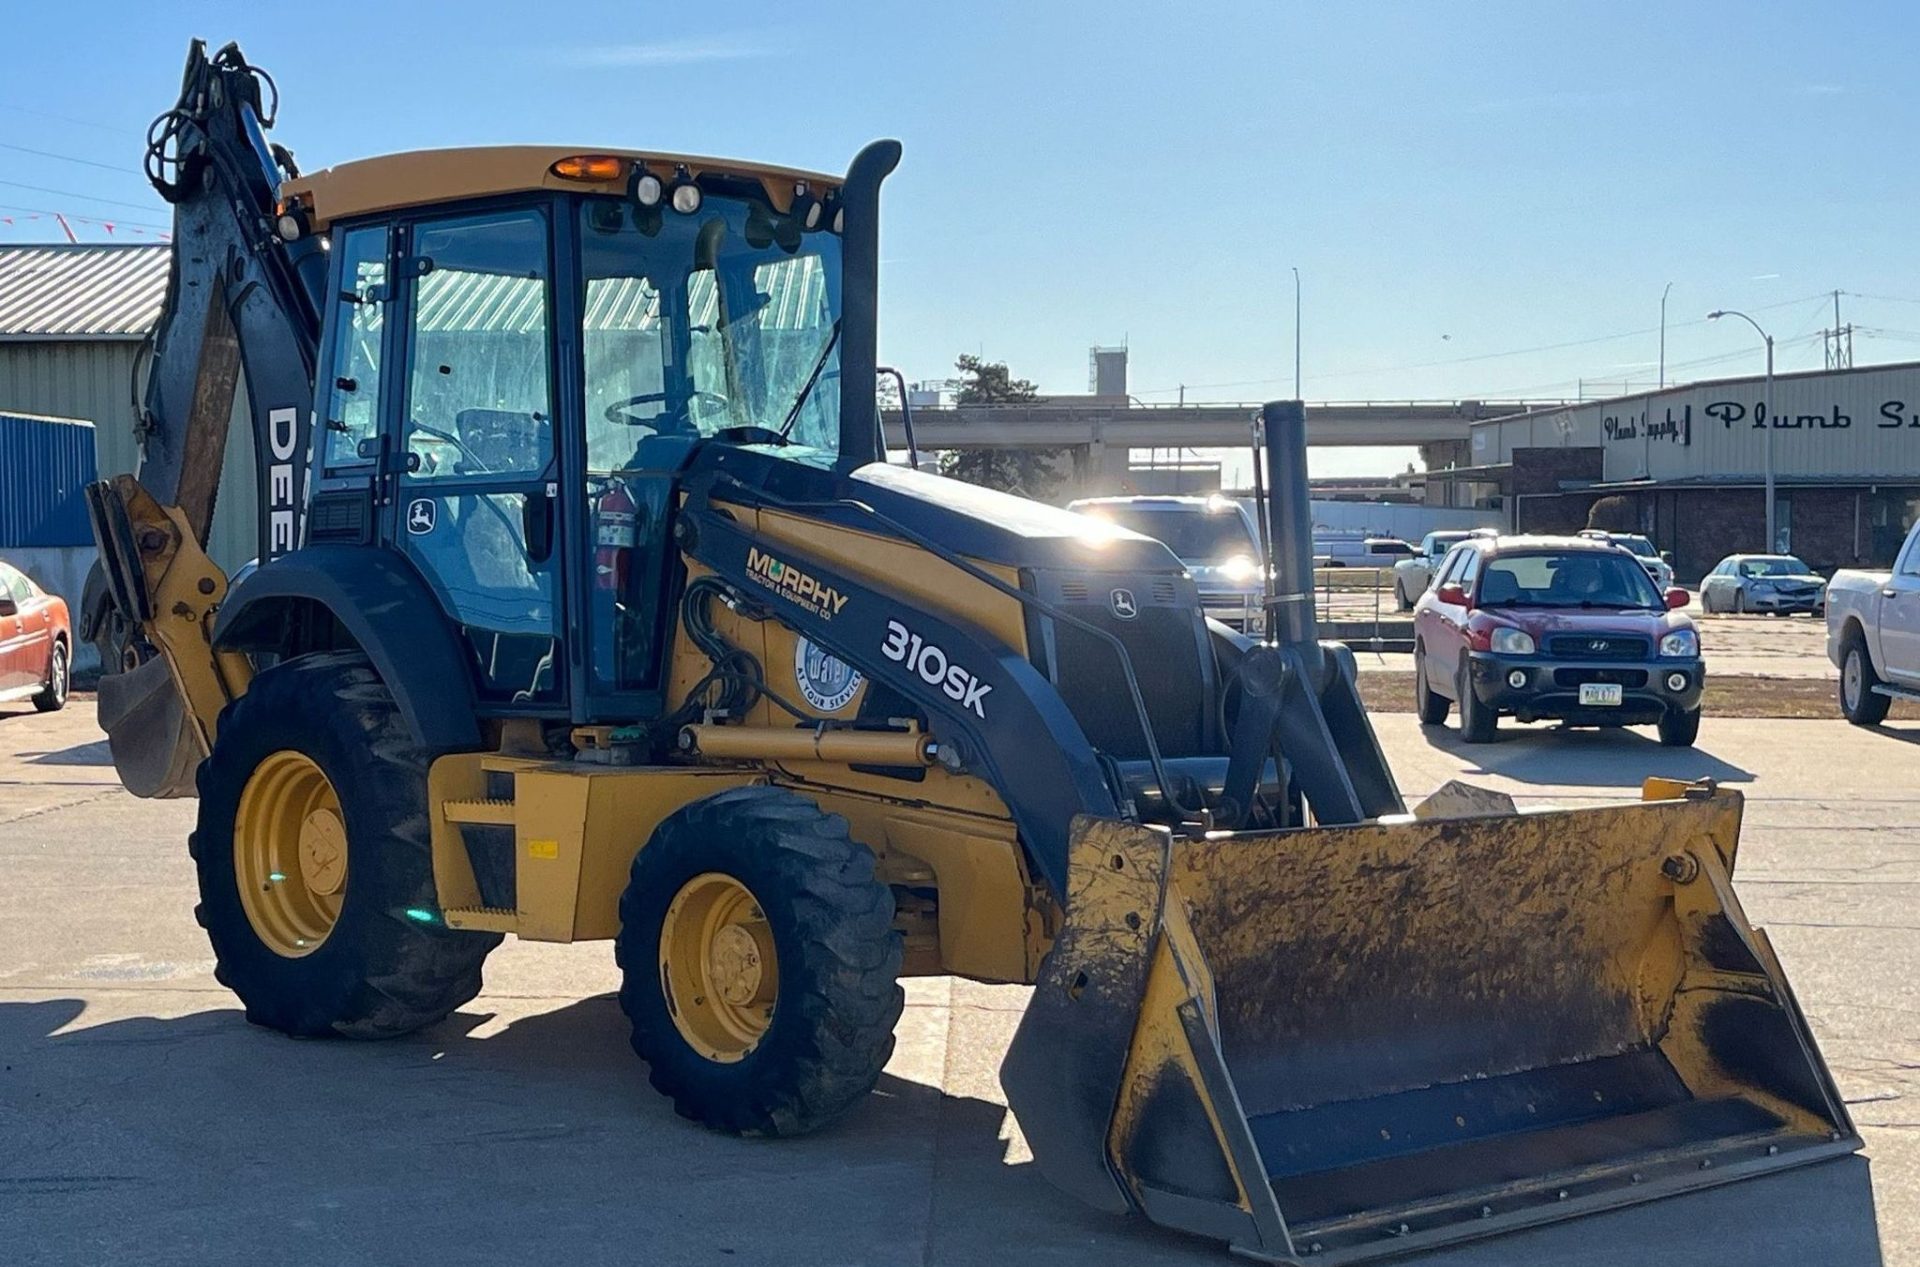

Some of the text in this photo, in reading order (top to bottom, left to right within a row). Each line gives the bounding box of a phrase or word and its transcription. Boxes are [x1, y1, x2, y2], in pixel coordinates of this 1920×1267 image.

[1705, 402, 1850, 429] Plumb
[269, 407, 297, 562] DEE
[745, 568, 777, 590] TRACTOR
[781, 589, 819, 614] EQUIPMENT
[747, 547, 849, 614] MURPHY
[797, 667, 805, 681] AT
[803, 684, 825, 708] YOUR
[881, 620, 993, 719] 310SK
